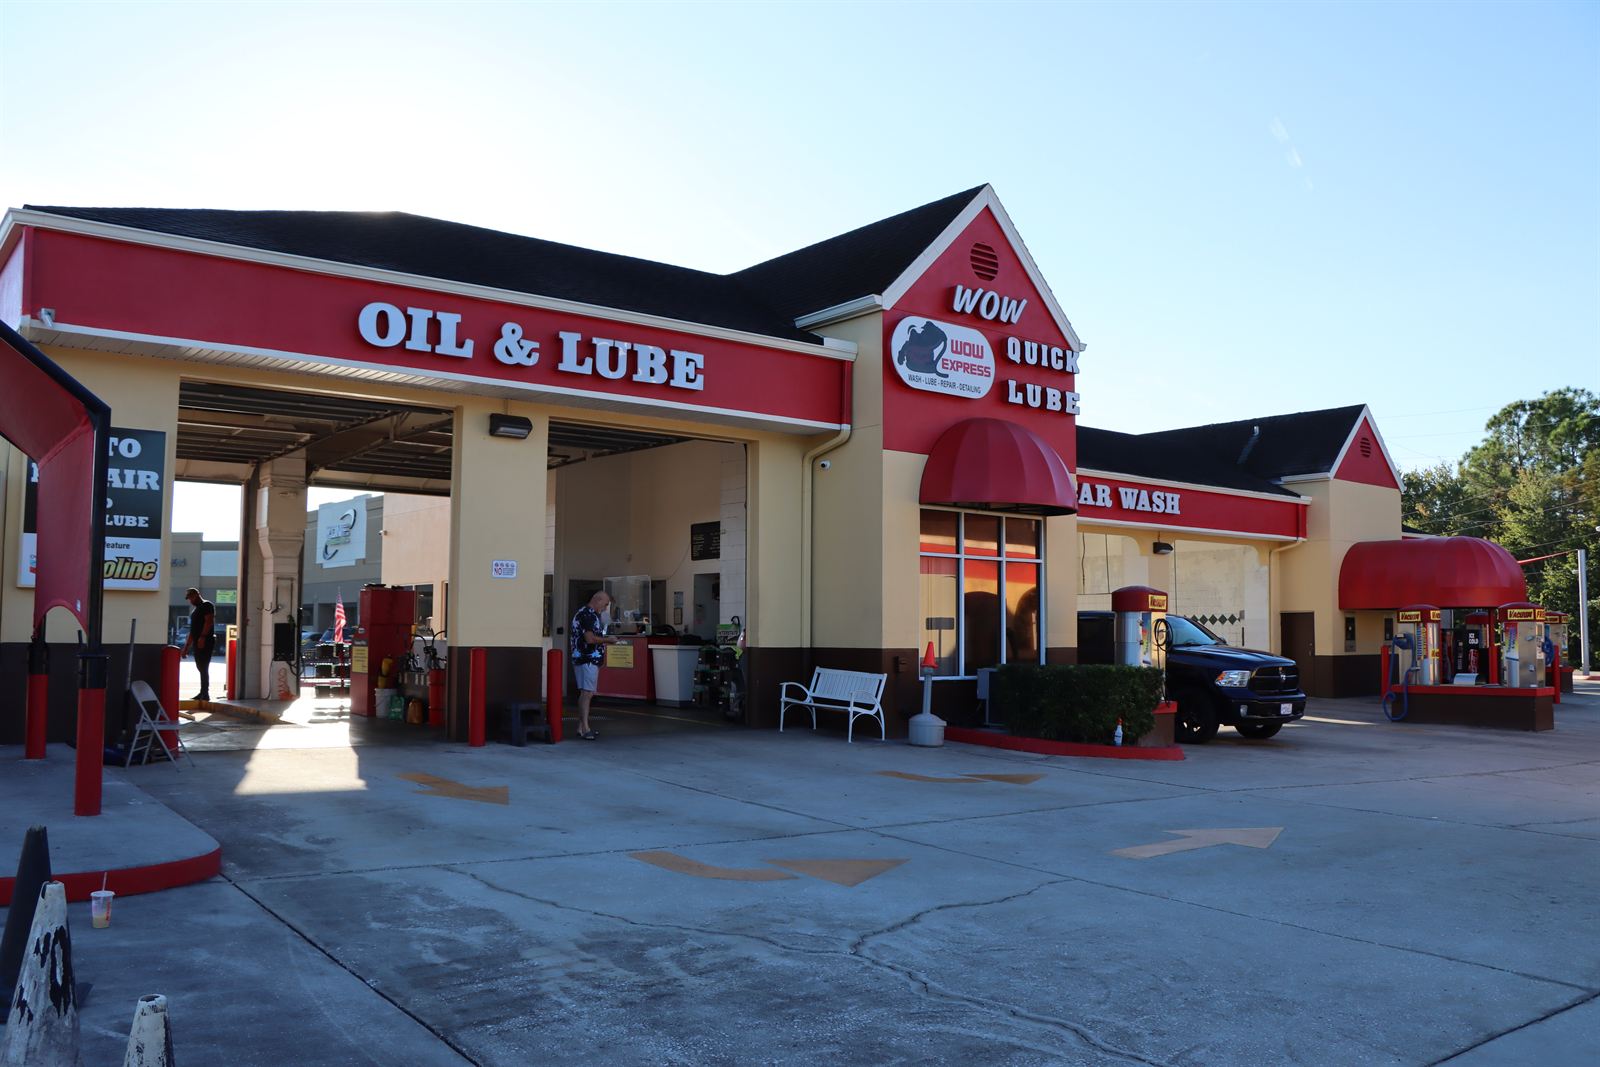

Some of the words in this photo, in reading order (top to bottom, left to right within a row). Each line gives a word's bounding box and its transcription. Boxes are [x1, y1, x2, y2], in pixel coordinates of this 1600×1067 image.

[953, 284, 1028, 324] WOW
[358, 301, 475, 359] OIL
[493, 321, 540, 367] &
[557, 330, 705, 391] LUBE
[951, 339, 984, 359] WOW
[1007, 336, 1080, 374] QUICK
[941, 358, 991, 377] EXPRESS
[908, 373, 922, 383] WASH
[924, 377, 937, 386] LUBE
[940, 380, 956, 388] REPAIR
[959, 383, 981, 394] DETAILING
[1008, 379, 1080, 415] LUBE
[1077, 482, 1112, 508] AR
[1118, 487, 1181, 515] WASH
[105, 514, 149, 528] LUBE
[105, 542, 131, 550] eature
